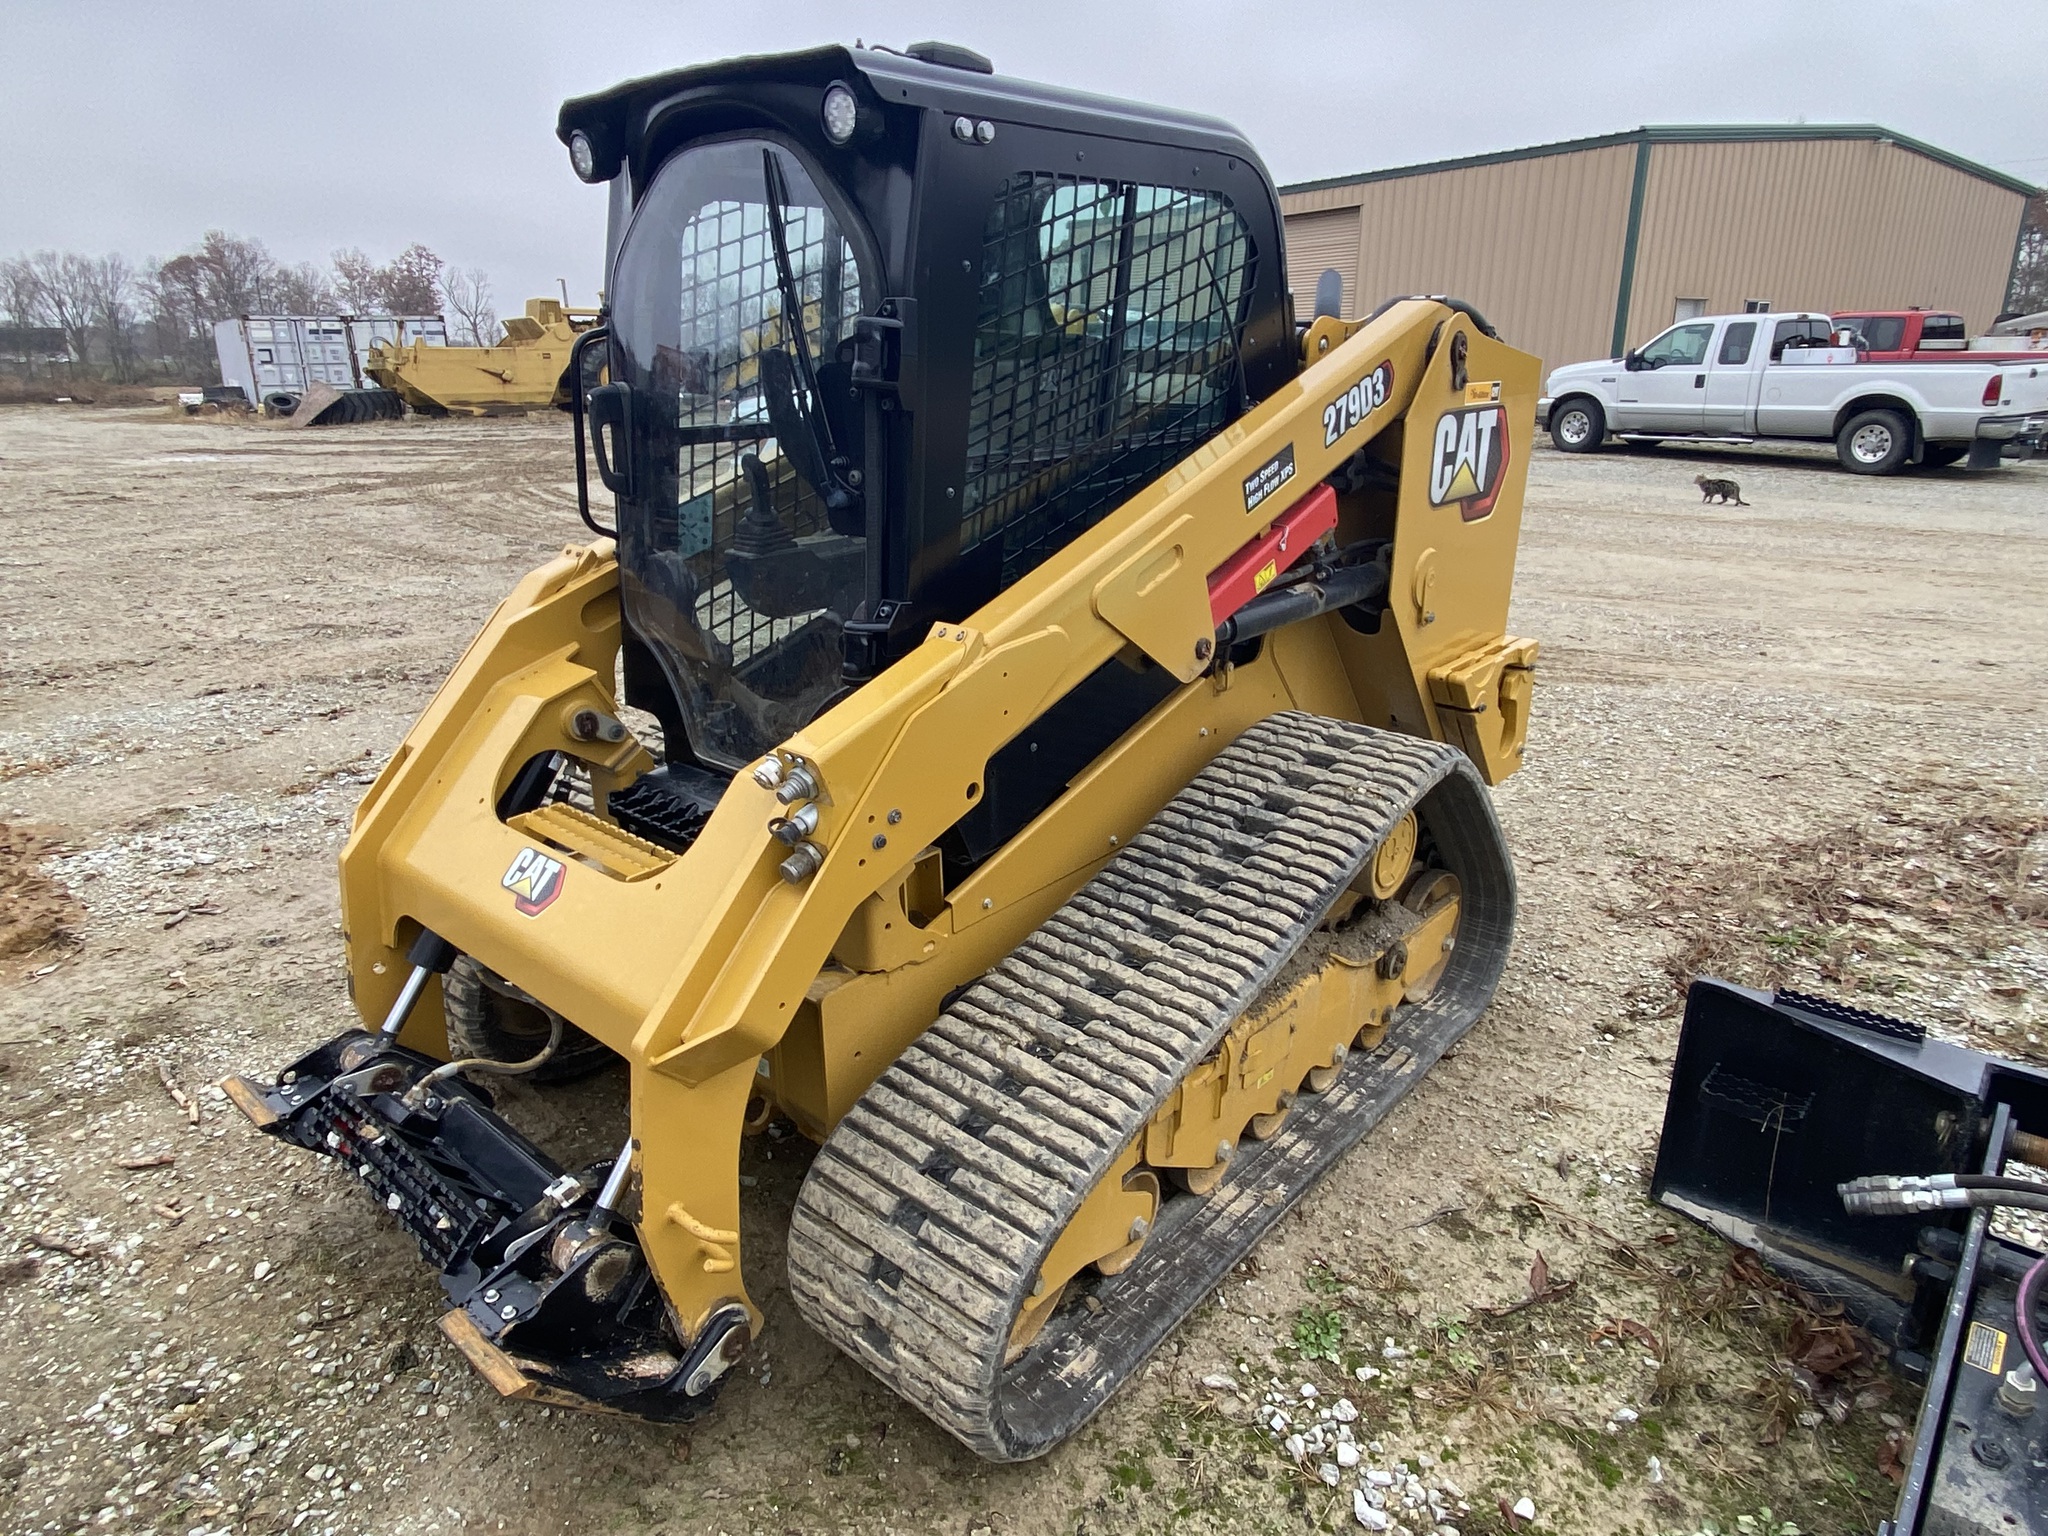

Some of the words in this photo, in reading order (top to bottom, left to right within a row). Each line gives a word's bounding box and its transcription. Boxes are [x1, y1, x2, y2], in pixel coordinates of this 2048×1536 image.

[1323, 367, 1385, 447] 279D3
[1280, 462, 1294, 482] XPS
[1430, 408, 1498, 504] CAT
[502, 848, 562, 902] CAT
